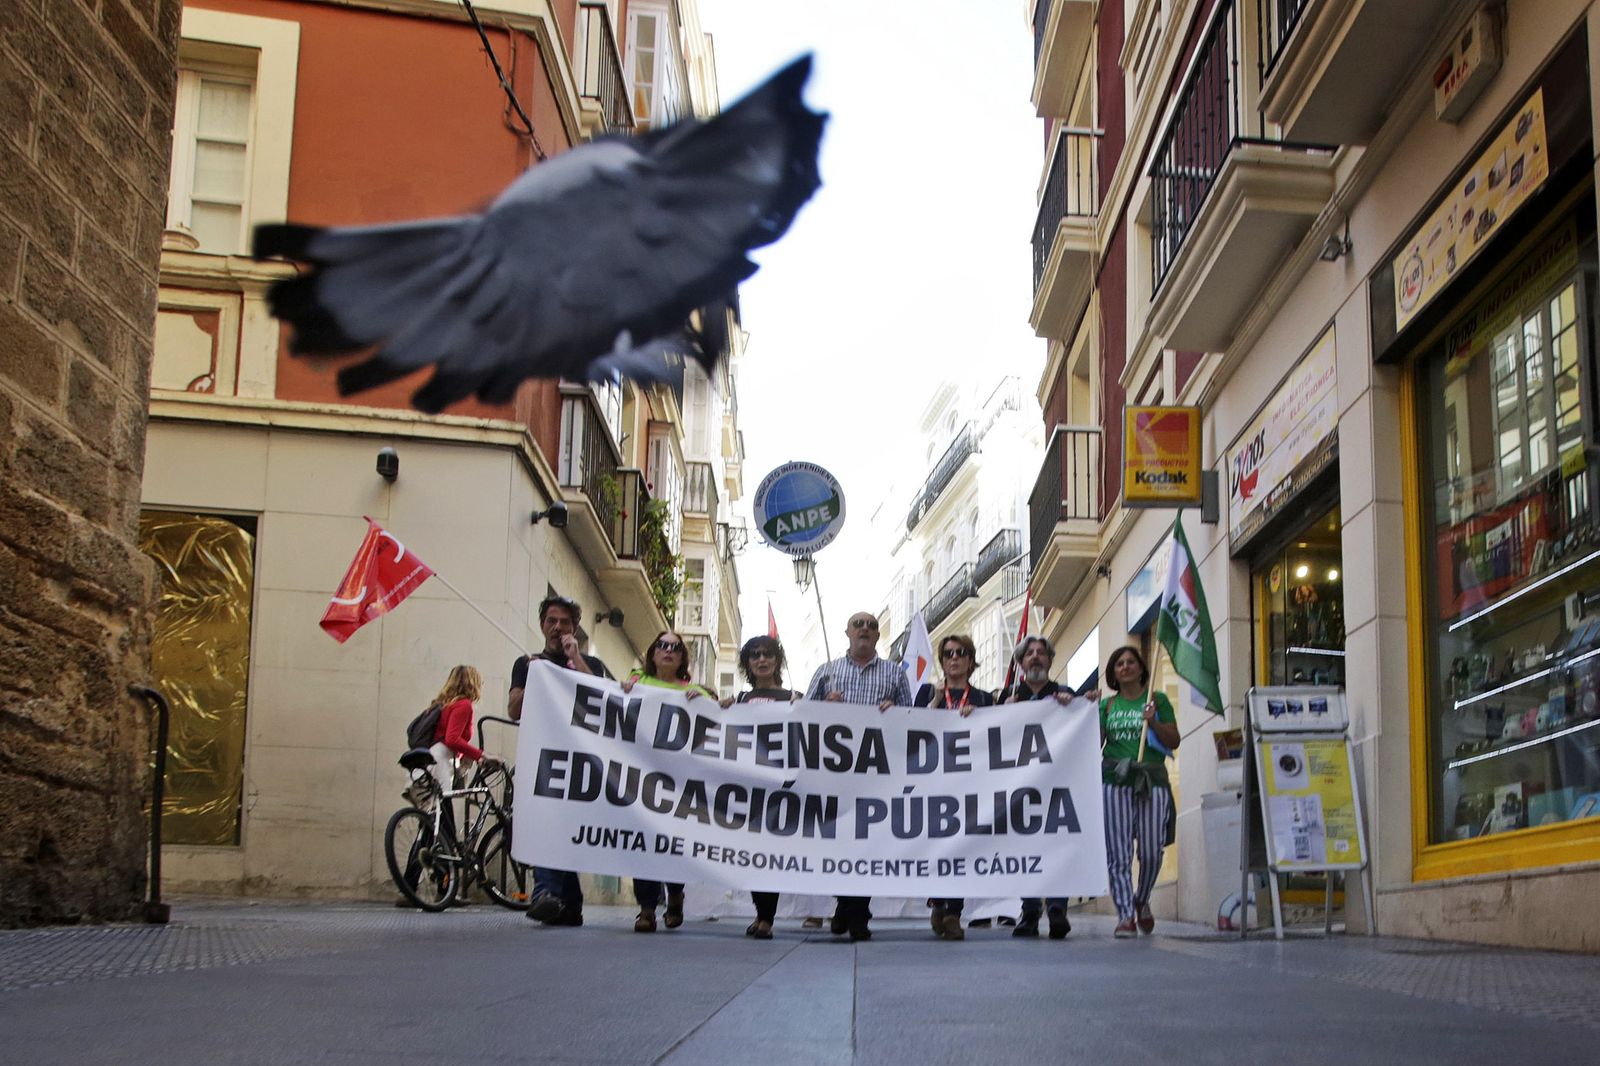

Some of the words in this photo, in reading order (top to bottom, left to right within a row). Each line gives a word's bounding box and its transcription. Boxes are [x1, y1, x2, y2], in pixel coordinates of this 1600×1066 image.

[780, 463, 838, 488] INDEPENDIENTE
[1135, 471, 1187, 485] Kodak
[775, 505, 832, 537] ANPE
[571, 683, 643, 743] EN
[653, 702, 891, 775] DEFENSA
[906, 729, 972, 775] DE
[987, 723, 1053, 771] LA
[533, 748, 839, 840] EDUCACIÓN
[854, 785, 1082, 840] PÚBLICA
[571, 825, 647, 852] JUNTA
[654, 834, 685, 857] DE
[692, 841, 814, 873] PERSONAL
[822, 857, 930, 877] DOCENTE
[937, 857, 967, 877] DE
[974, 852, 1043, 876] CÁDIZ
